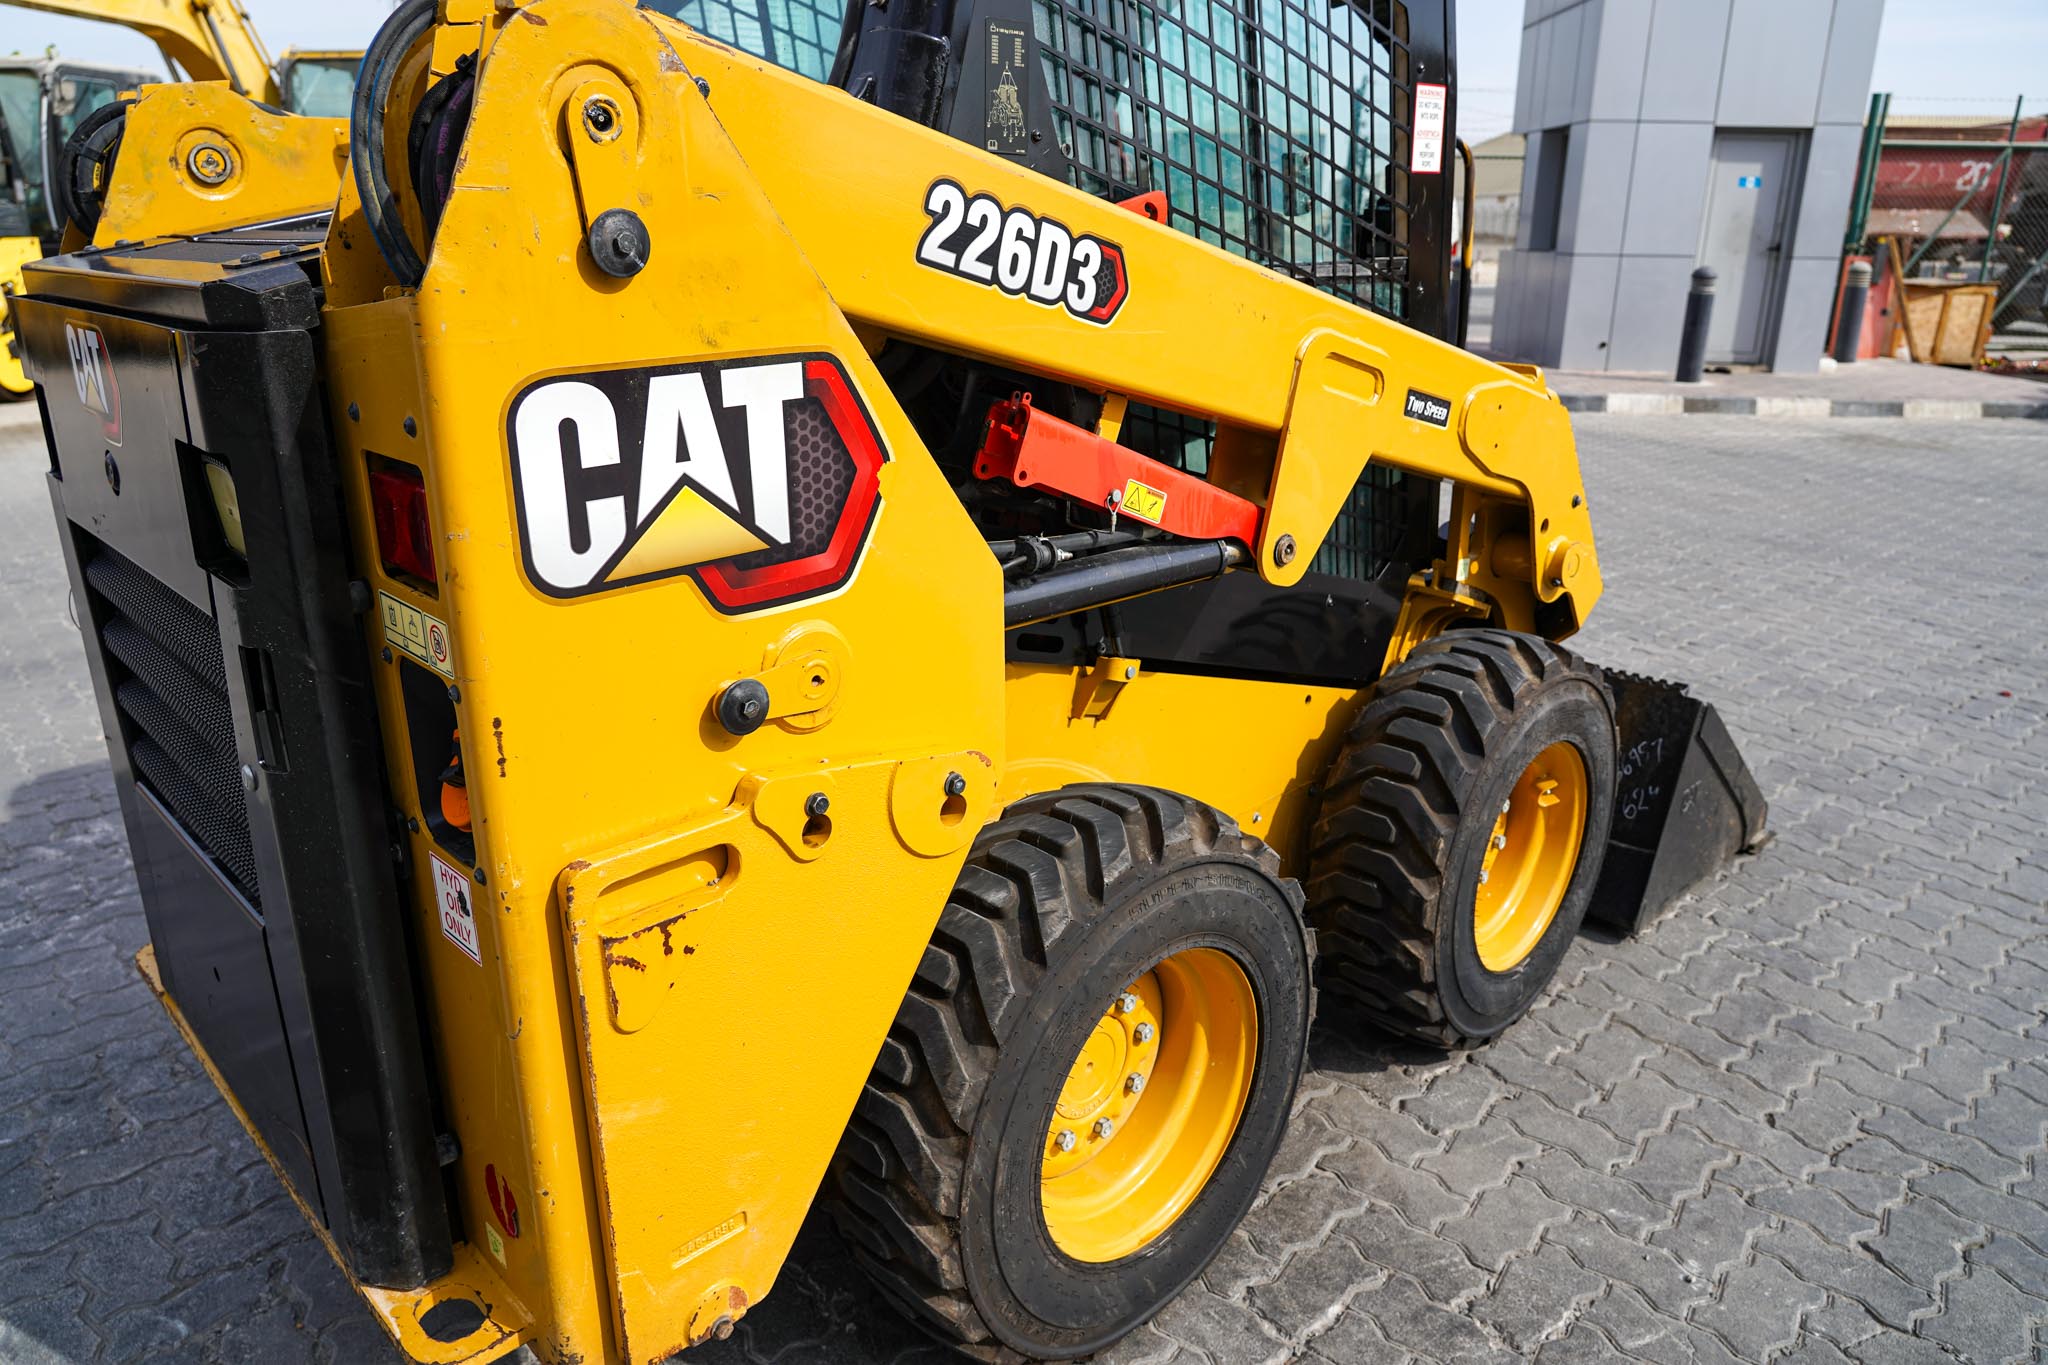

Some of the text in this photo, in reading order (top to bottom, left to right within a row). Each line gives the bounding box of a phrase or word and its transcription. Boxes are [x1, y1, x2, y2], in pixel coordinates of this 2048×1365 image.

[920, 184, 1102, 312] 226D3
[66, 323, 109, 414] CAT
[515, 362, 805, 588] CAT
[445, 911, 471, 945] ONLY
[446, 892, 465, 919] OIL
